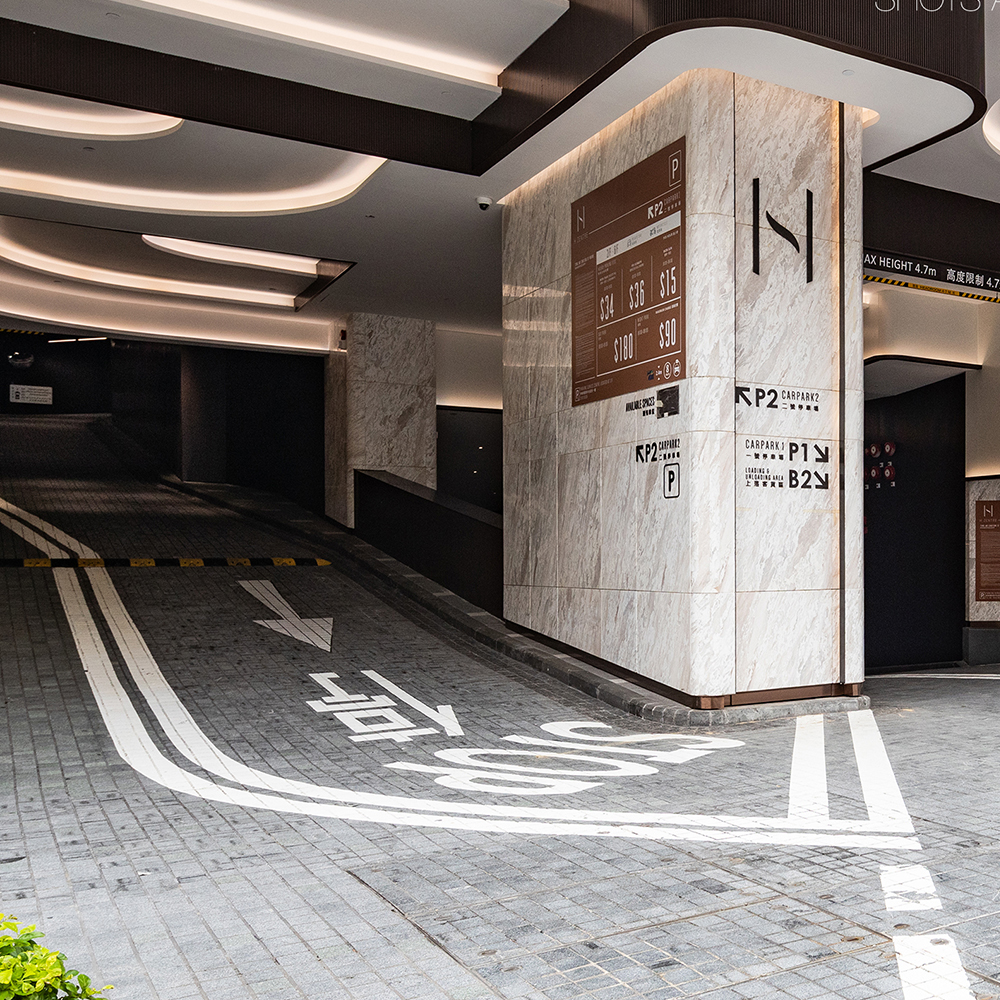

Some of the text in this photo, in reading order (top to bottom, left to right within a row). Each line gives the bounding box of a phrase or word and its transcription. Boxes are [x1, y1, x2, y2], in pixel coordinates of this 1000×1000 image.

[672, 158, 679, 179] P
[654, 200, 664, 217] P2
[863, 253, 937, 277] AX HEIGHT 4.7m
[659, 266, 676, 299] $15
[946, 268, 985, 287] 高度限制
[629, 279, 645, 311] $36
[600, 293, 614, 322] $34
[659, 317, 677, 350] $90
[613, 332, 634, 364] $180
[755, 387, 820, 409] P2 CARPARK2
[645, 441, 658, 463] P2
[789, 442, 808, 462] P1
[668, 470, 675, 493] P
[788, 469, 812, 489] B2
[305, 669, 465, 743] 停
[383, 720, 746, 795] STOP
